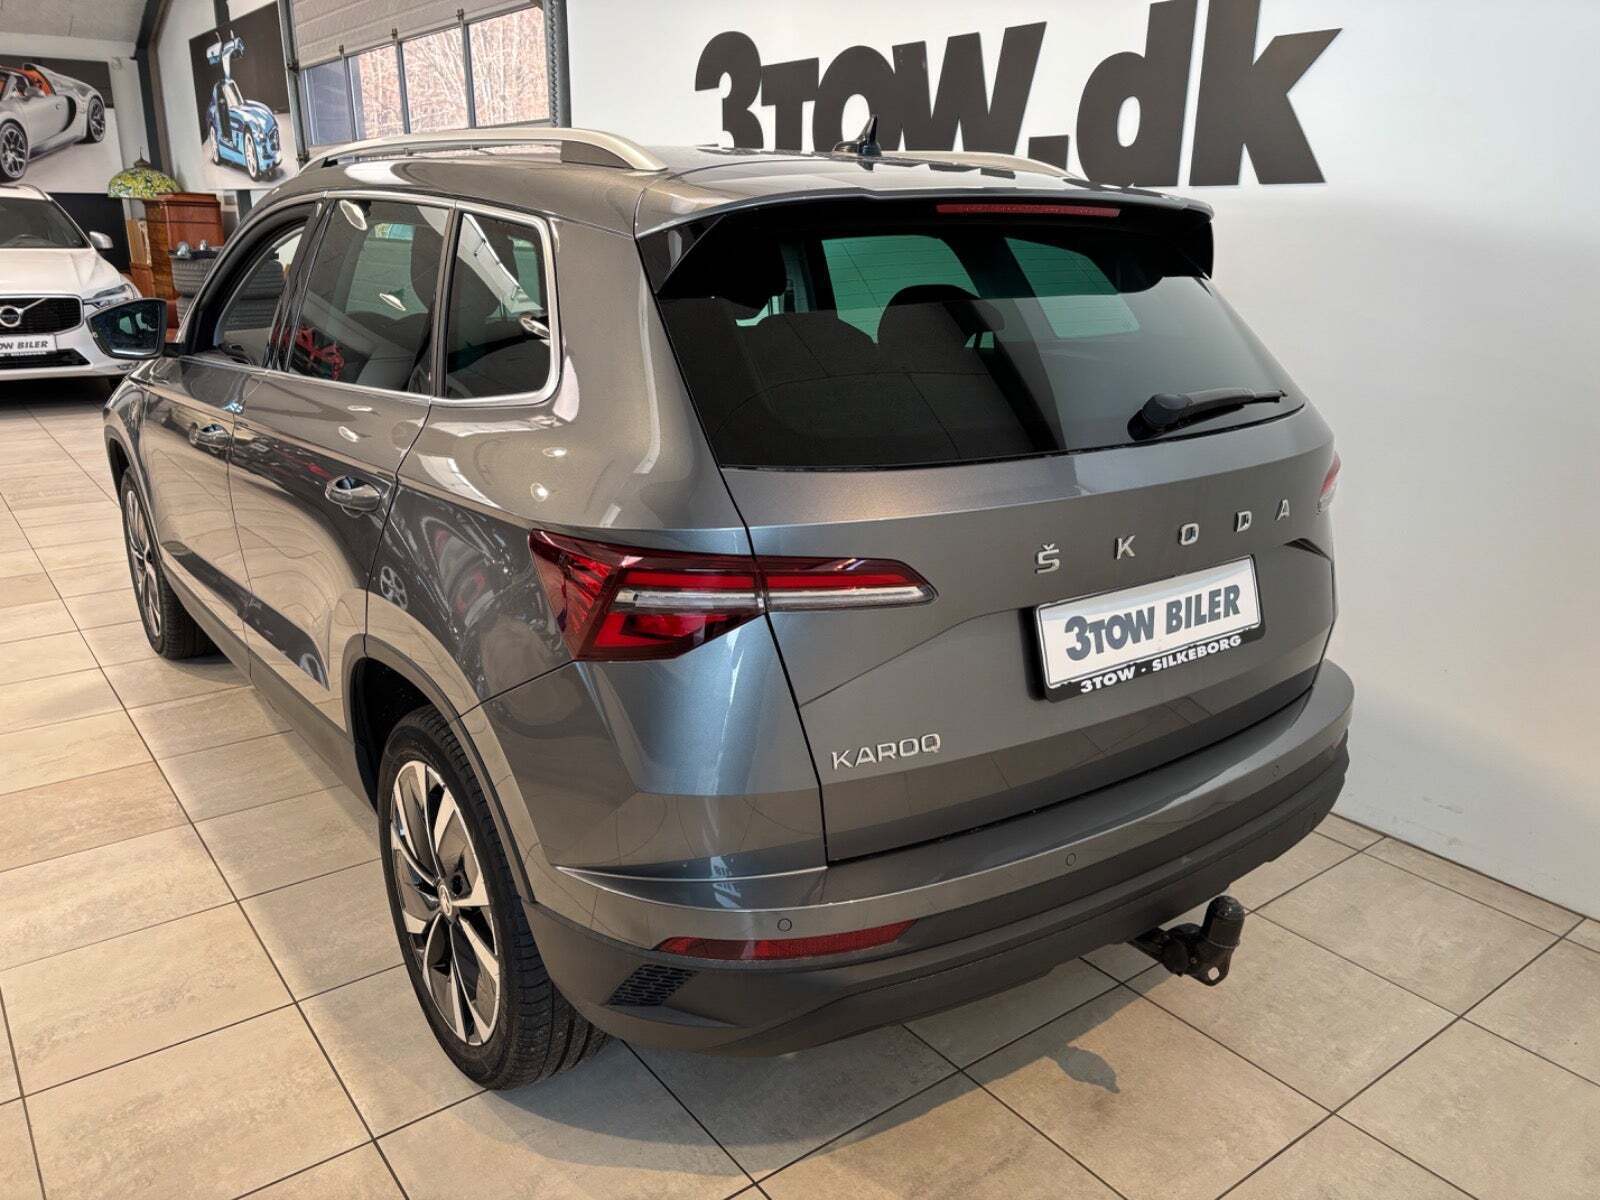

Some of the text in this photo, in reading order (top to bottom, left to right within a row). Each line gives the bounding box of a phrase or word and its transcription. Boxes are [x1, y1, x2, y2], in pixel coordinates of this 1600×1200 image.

[17, 340, 49, 349] BILER
[1035, 499, 1291, 574] ŠKODA
[1064, 584, 1241, 661] 3TOW BILER
[1080, 635, 1242, 693] 3TOW SILKEBORG
[831, 733, 941, 770] KAROQ
